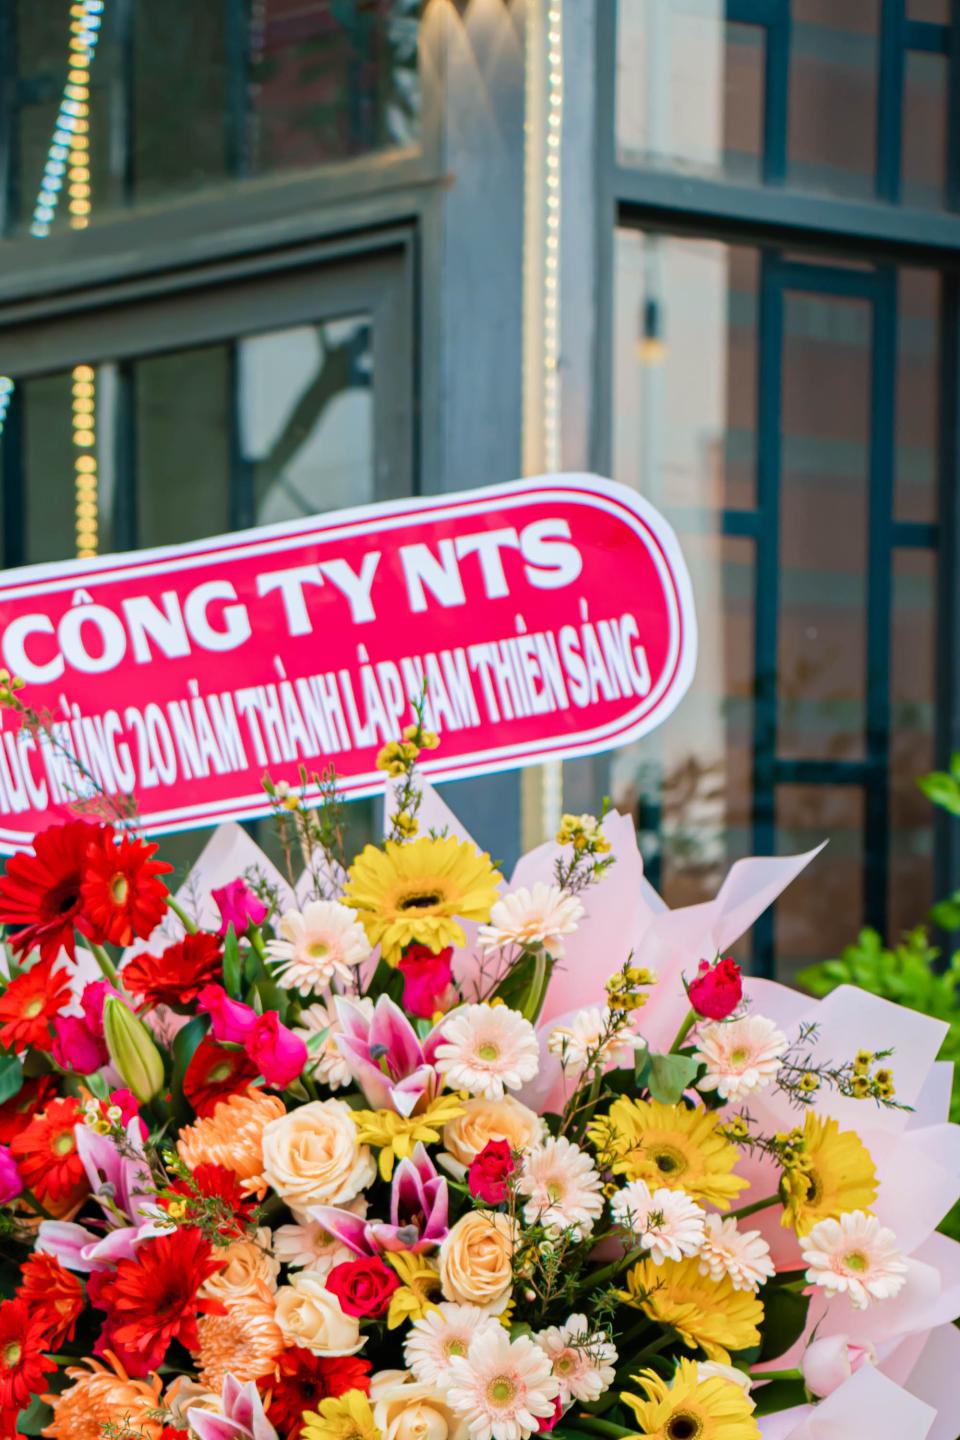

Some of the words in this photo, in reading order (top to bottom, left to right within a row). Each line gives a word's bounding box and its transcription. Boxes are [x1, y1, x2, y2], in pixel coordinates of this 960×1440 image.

[1, 588, 252, 684] CÔNG
[256, 550, 382, 637] TY
[398, 517, 583, 612] NTS
[124, 702, 178, 789] 20
[166, 678, 249, 781] NĂM
[234, 654, 352, 768] THÀNH
[558, 596, 652, 709] SÁNG
